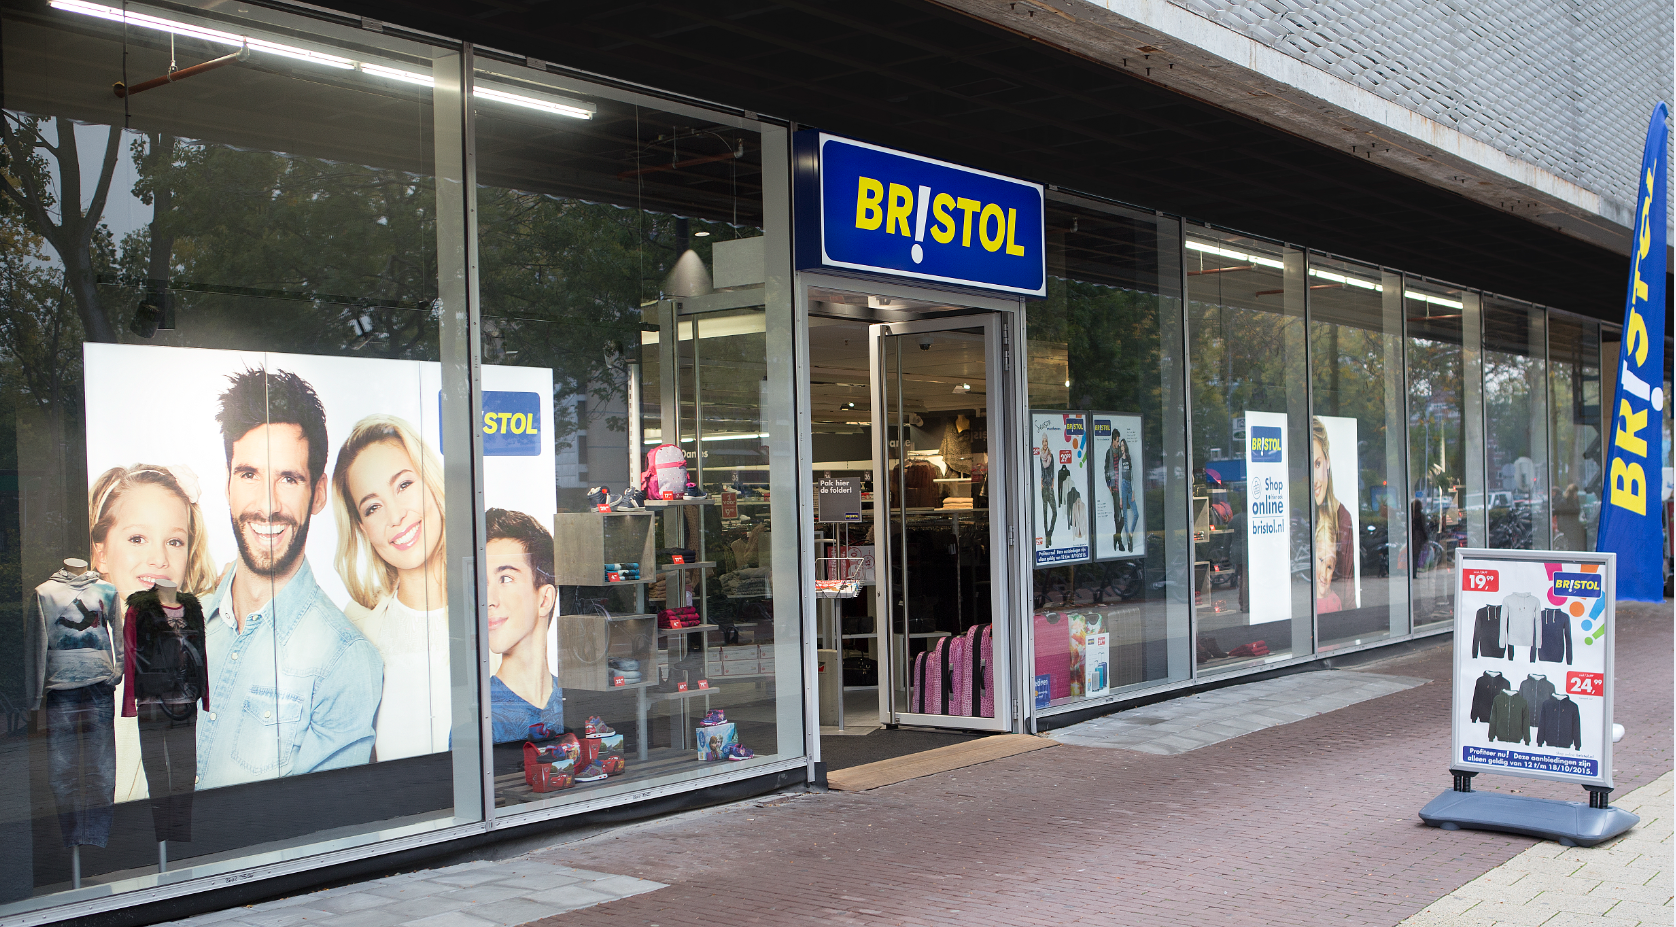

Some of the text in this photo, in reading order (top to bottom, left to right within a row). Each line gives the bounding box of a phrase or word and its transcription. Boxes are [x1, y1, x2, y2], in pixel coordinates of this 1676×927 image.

[482, 411, 538, 435] STOL
[820, 486, 829, 494] de
[835, 479, 850, 487] hier
[1264, 476, 1284, 494] Shop
[1252, 494, 1284, 515] online
[1252, 519, 1285, 535] bristol.nl
[1467, 755, 1487, 763] alleen
[1487, 757, 1508, 767] geldig
[1533, 762, 1547, 770] t/m
[1469, 747, 1591, 768] Profiteer nu! Deze aanbiedingen zijn
